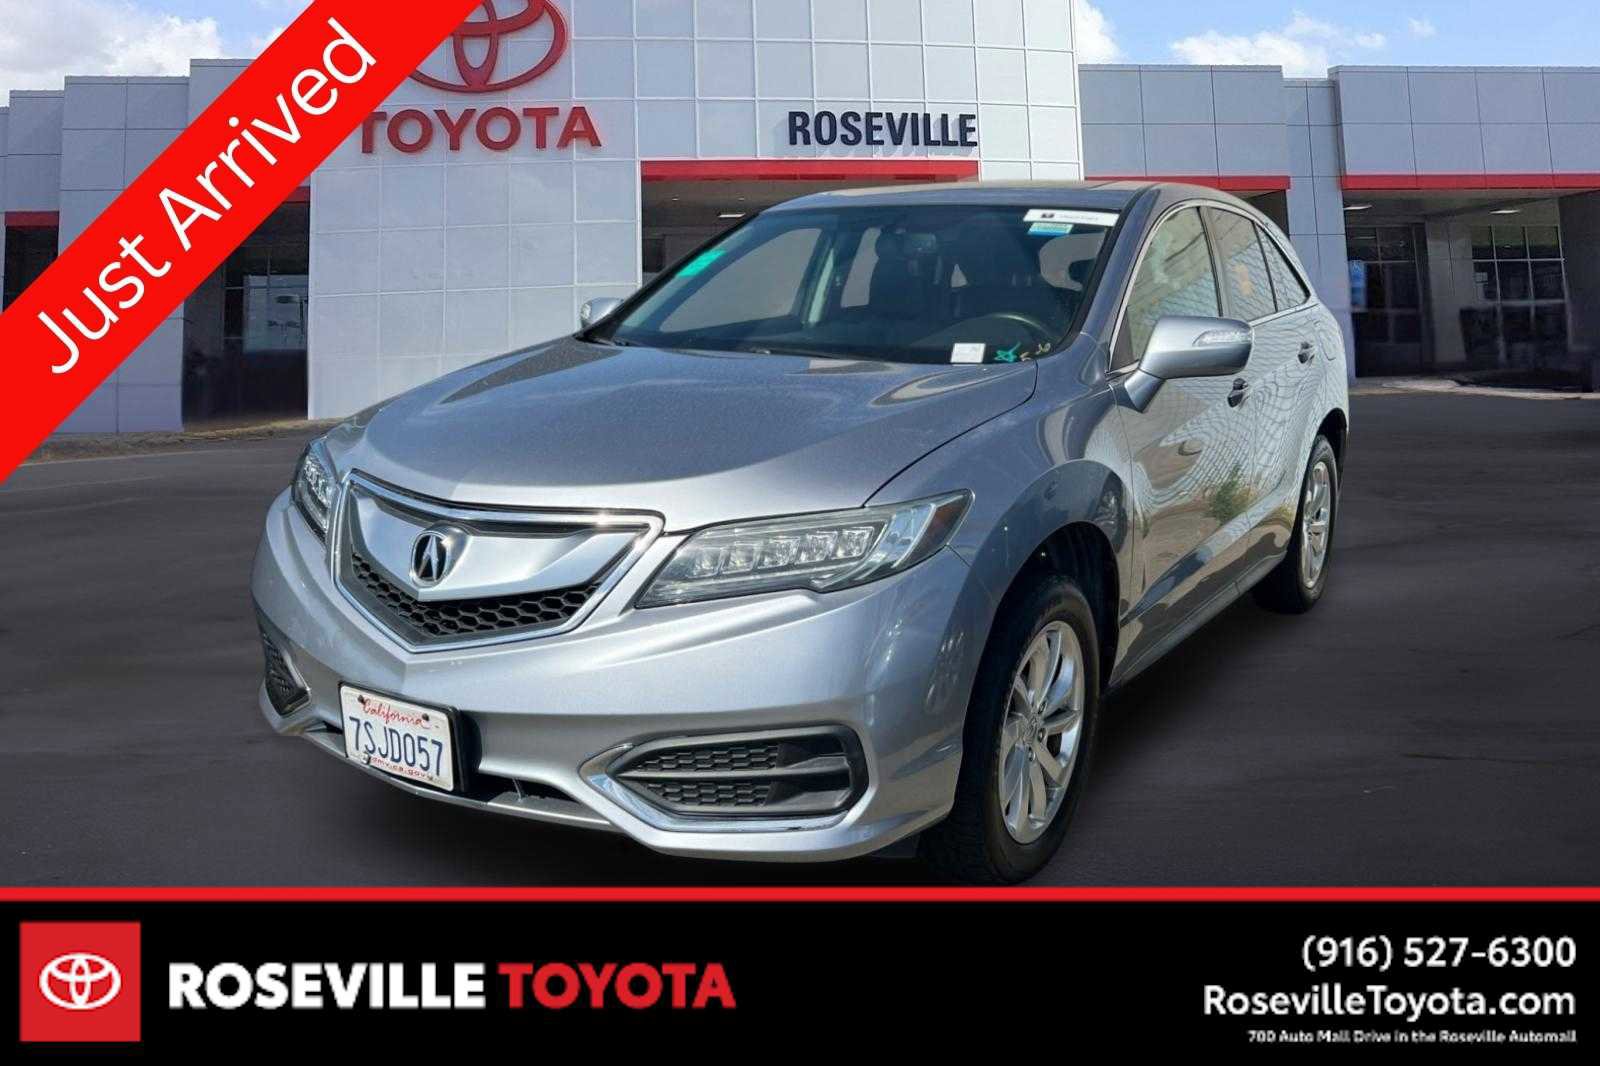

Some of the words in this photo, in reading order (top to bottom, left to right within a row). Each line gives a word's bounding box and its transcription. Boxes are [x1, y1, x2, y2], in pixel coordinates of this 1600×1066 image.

[361, 105, 602, 154] TOYOTA
[788, 110, 978, 147] ROSEVILLE
[361, 696, 431, 730] California
[348, 714, 444, 777] 7SJD057
